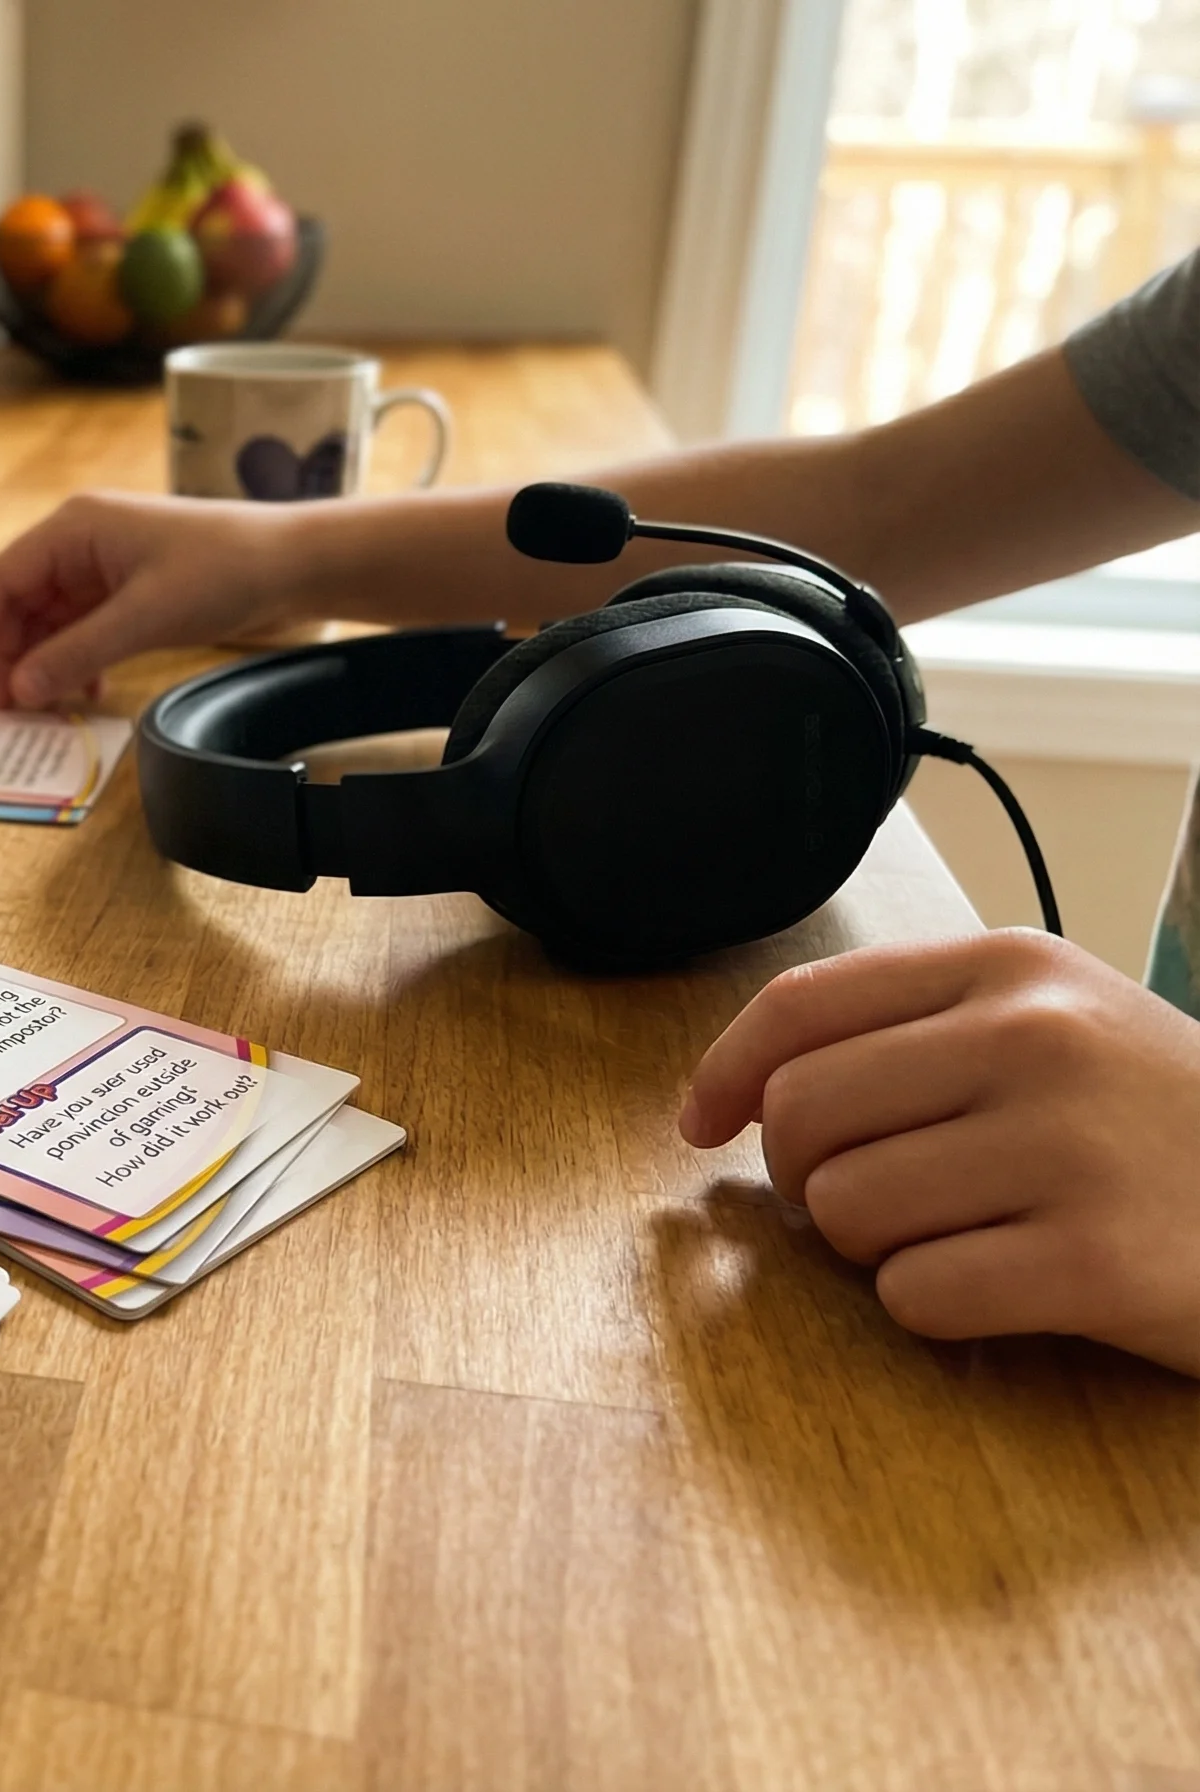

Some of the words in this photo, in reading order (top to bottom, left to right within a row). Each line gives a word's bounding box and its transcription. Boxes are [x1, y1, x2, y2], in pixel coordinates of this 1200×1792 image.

[15, 995, 47, 1015] the
[8, 1116, 62, 1149] Have
[56, 1095, 94, 1125] you
[109, 1128, 131, 1148] of
[95, 1154, 146, 1188] How
[142, 1130, 175, 1159] did
[172, 1124, 190, 1138] it
